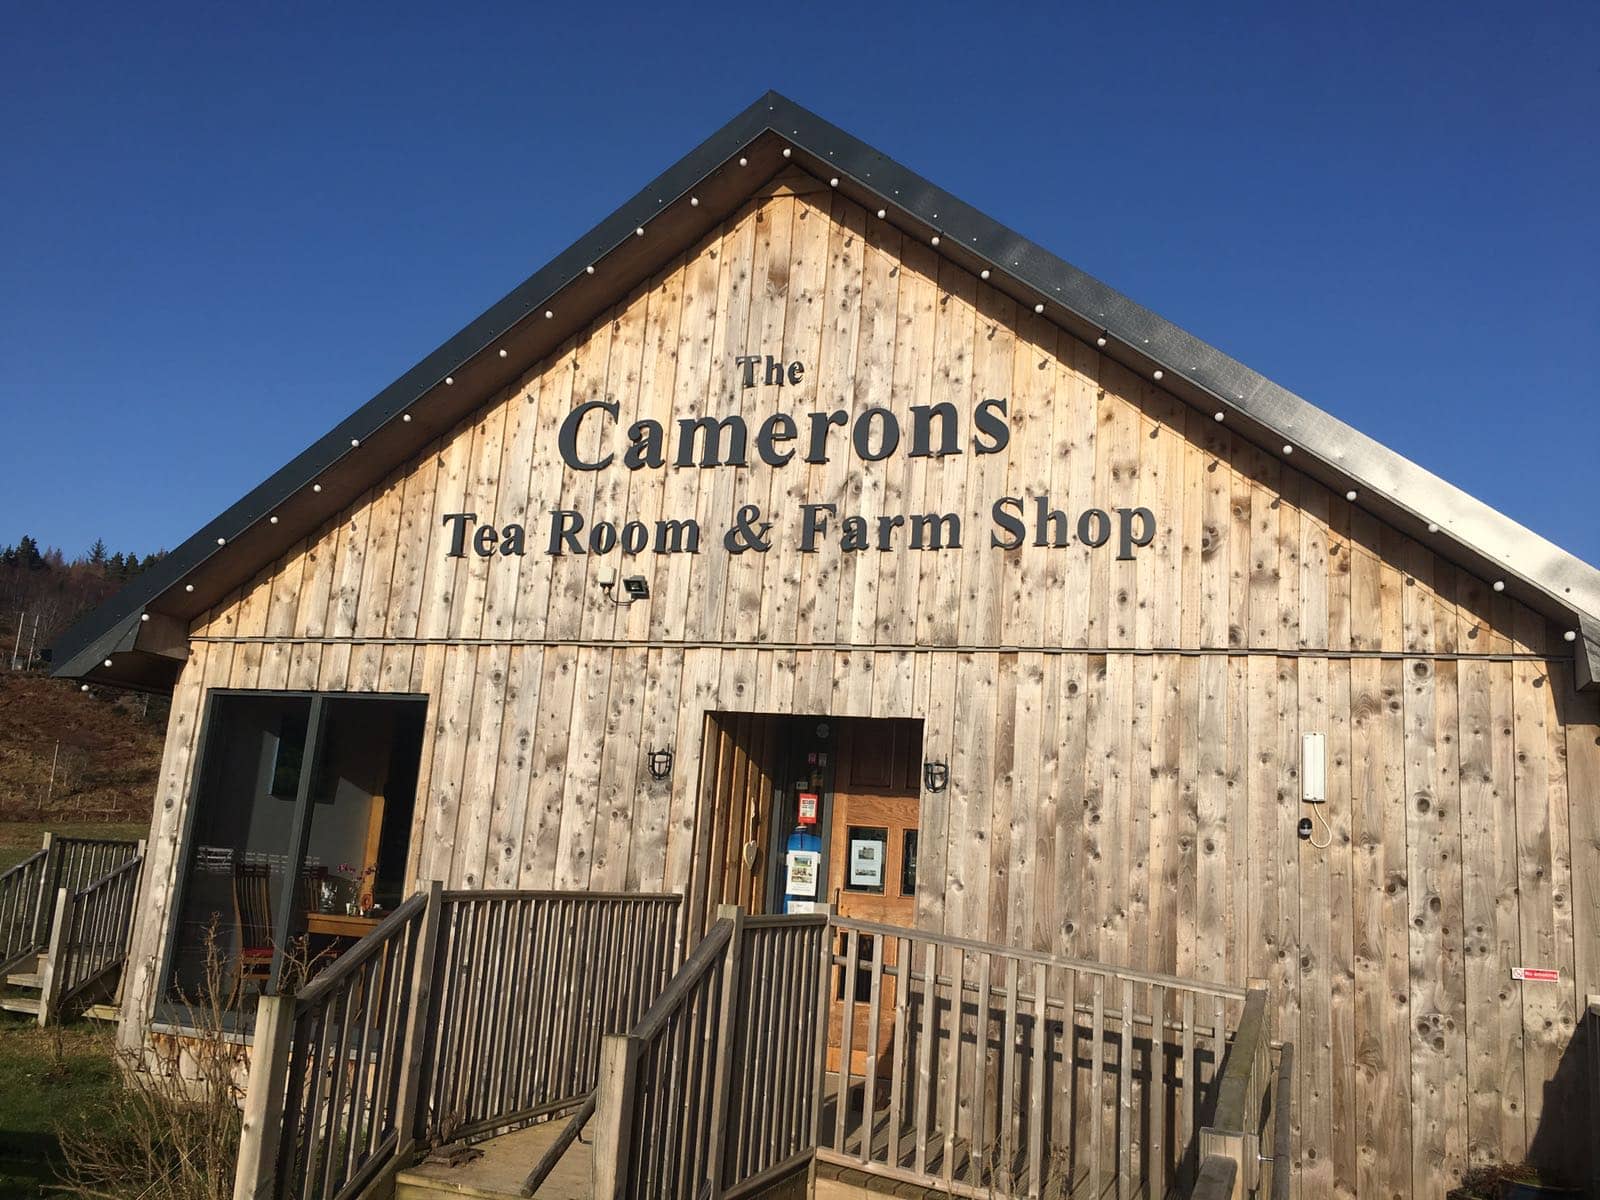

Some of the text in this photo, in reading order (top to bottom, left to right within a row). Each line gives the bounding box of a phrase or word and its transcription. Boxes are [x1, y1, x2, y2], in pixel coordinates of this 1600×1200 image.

[736, 355, 804, 388] The
[558, 398, 1010, 471] Camerons
[443, 496, 1156, 560] Tea Room & Farm Shop
